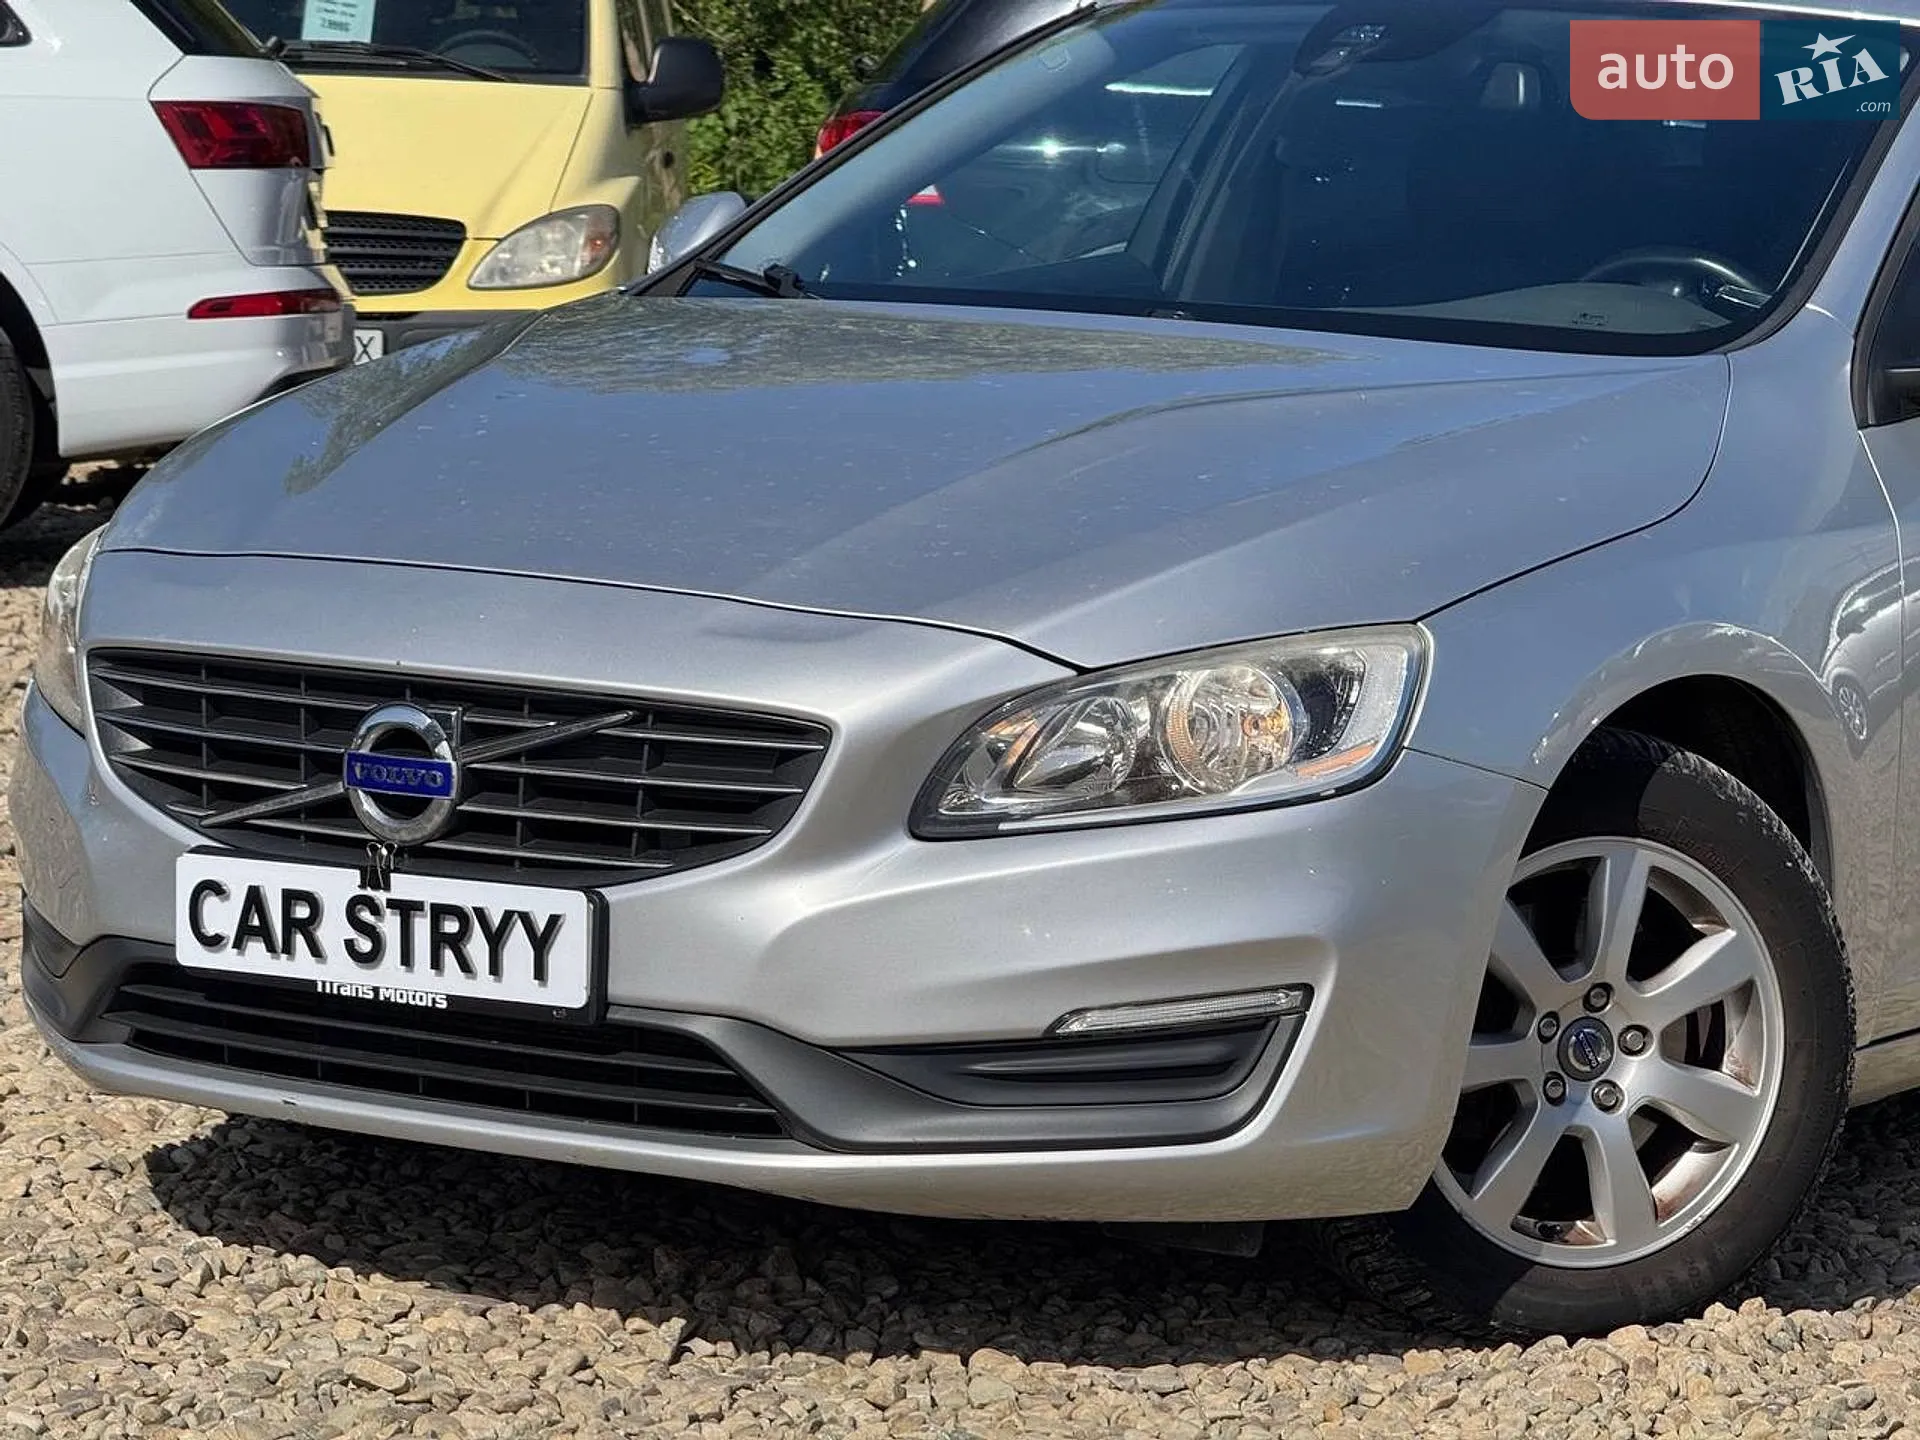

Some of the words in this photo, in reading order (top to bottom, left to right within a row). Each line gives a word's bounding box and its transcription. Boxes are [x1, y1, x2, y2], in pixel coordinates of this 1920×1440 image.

[351, 761, 444, 788] VOLVO
[188, 878, 326, 962] CAR
[343, 893, 566, 983] STRYY
